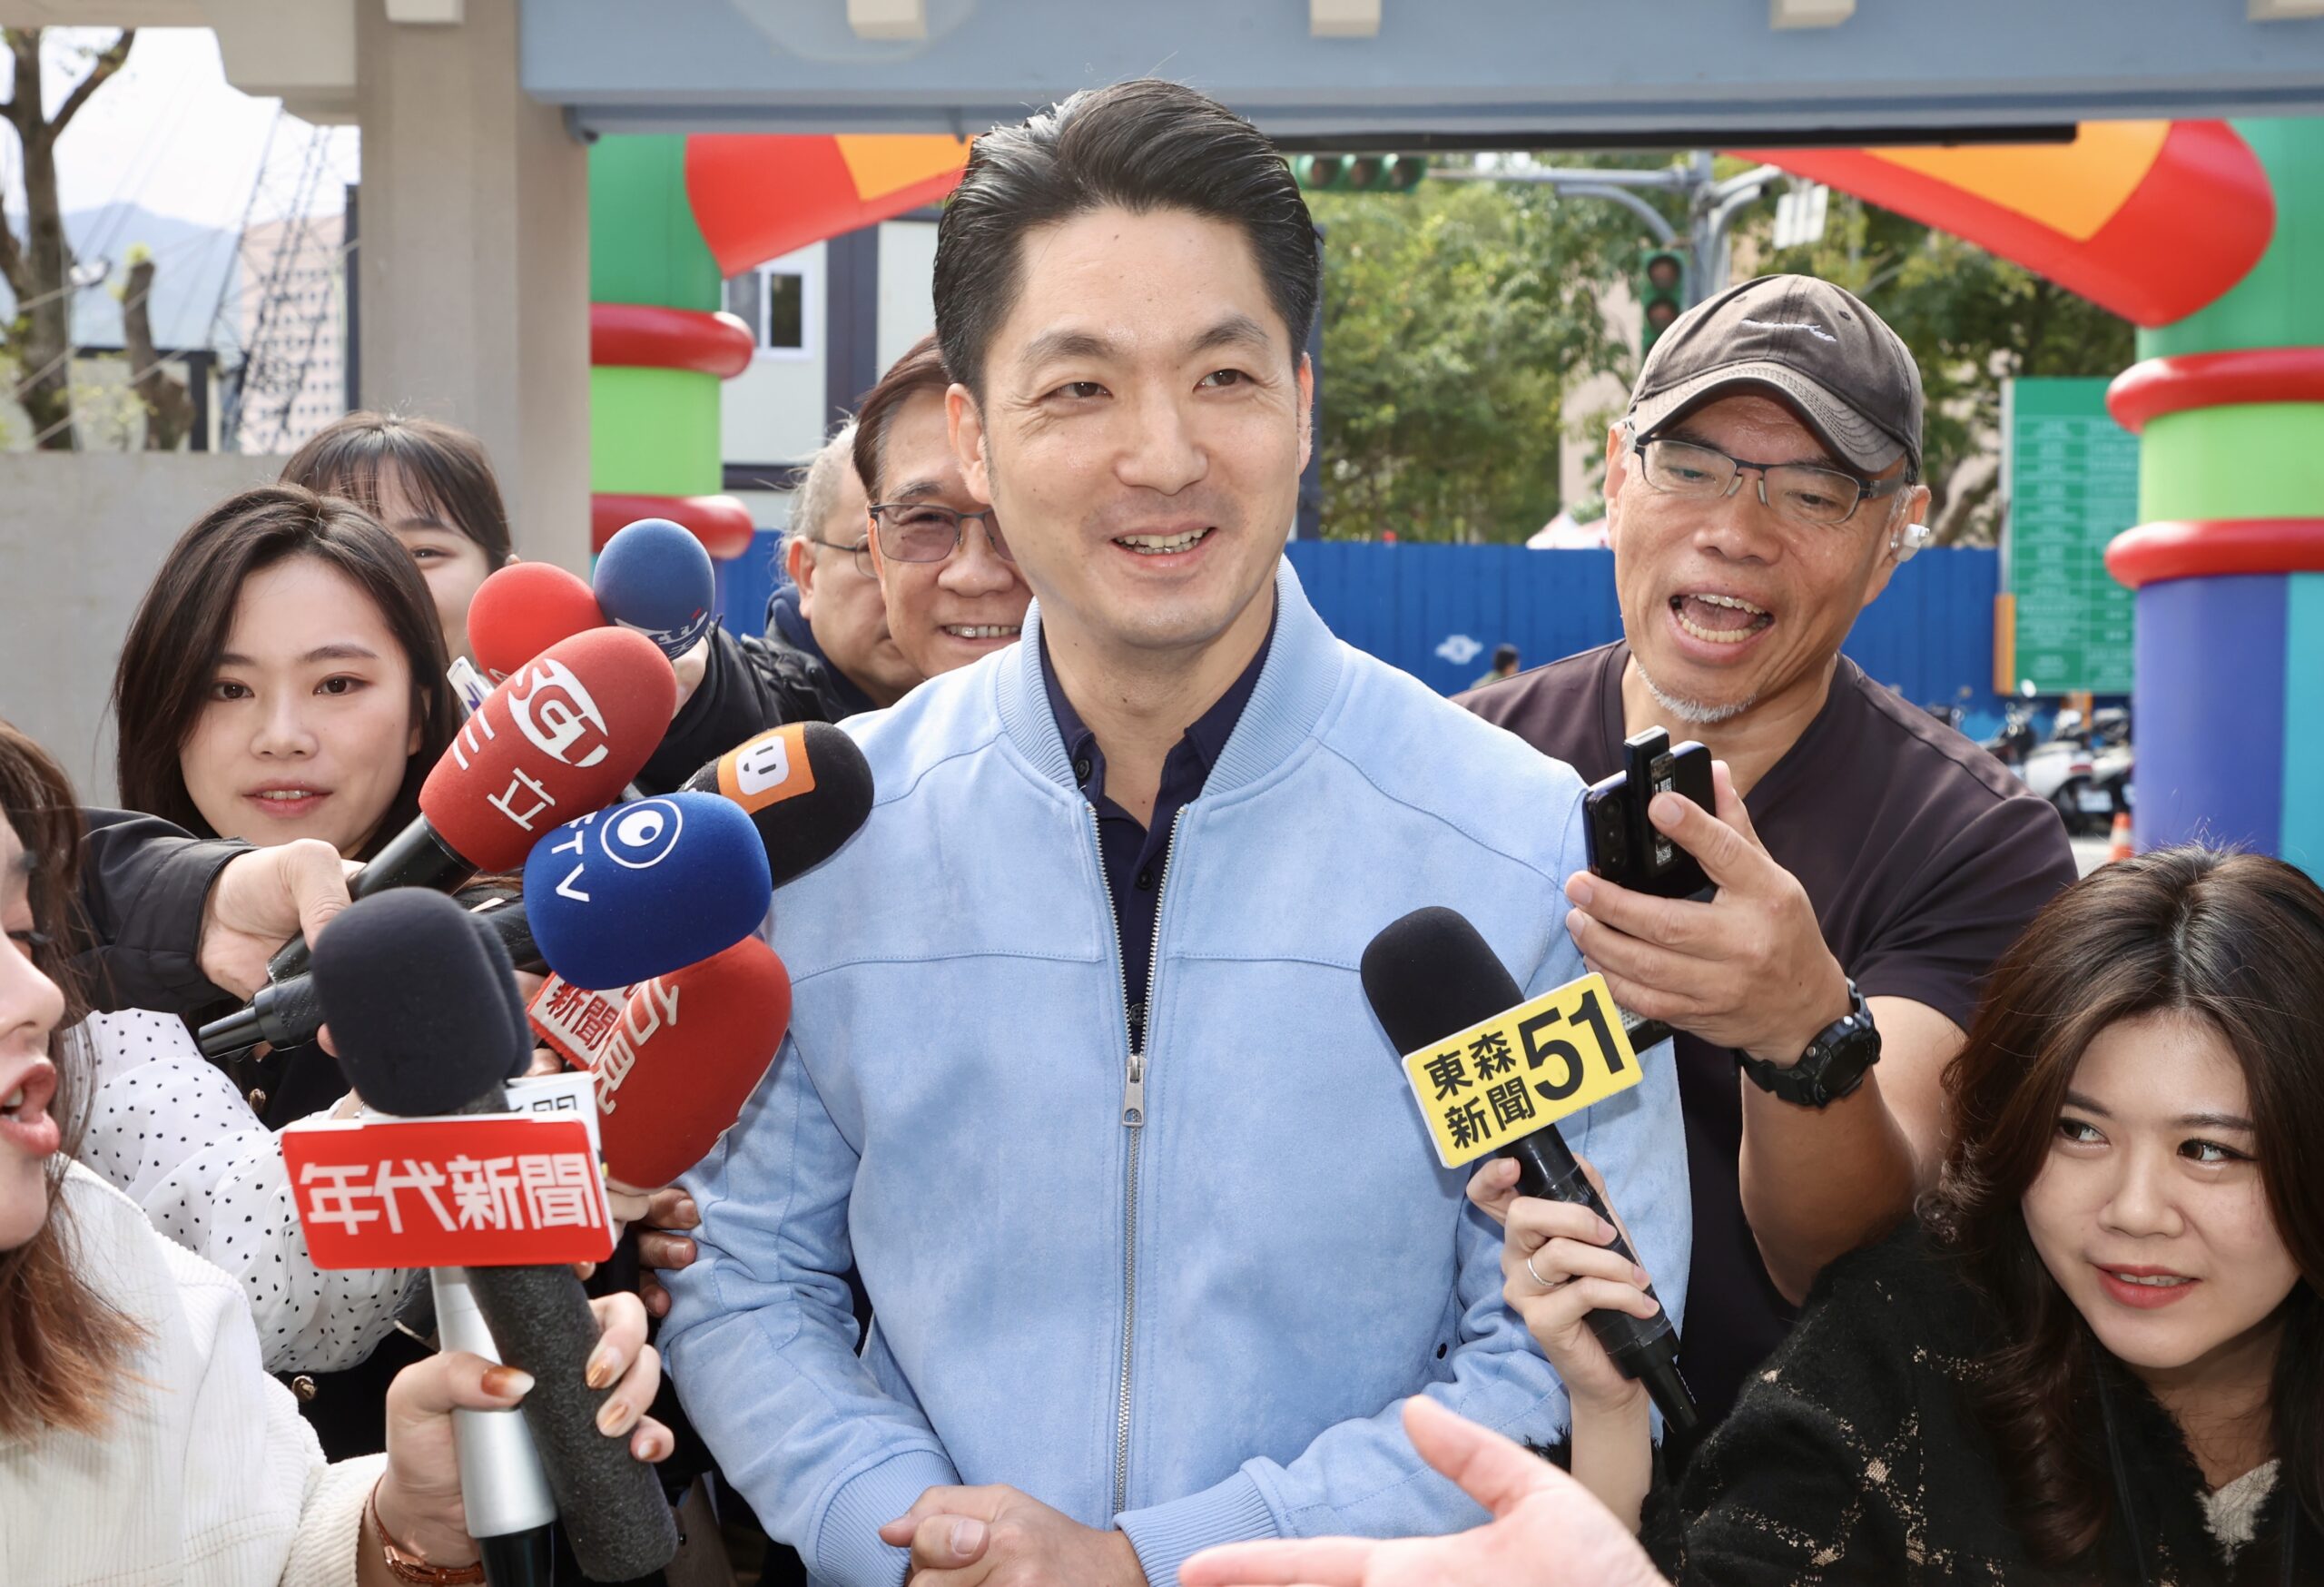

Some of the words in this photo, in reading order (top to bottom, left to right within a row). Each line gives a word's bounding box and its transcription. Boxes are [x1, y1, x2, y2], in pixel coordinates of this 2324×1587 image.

[453, 709, 556, 832] 三立
[547, 982, 619, 1051] 新聞
[1517, 989, 1625, 1101] 51
[1423, 1030, 1517, 1102] 東森
[1444, 1076, 1537, 1149] 新聞
[299, 1152, 603, 1237] 年代新聞
